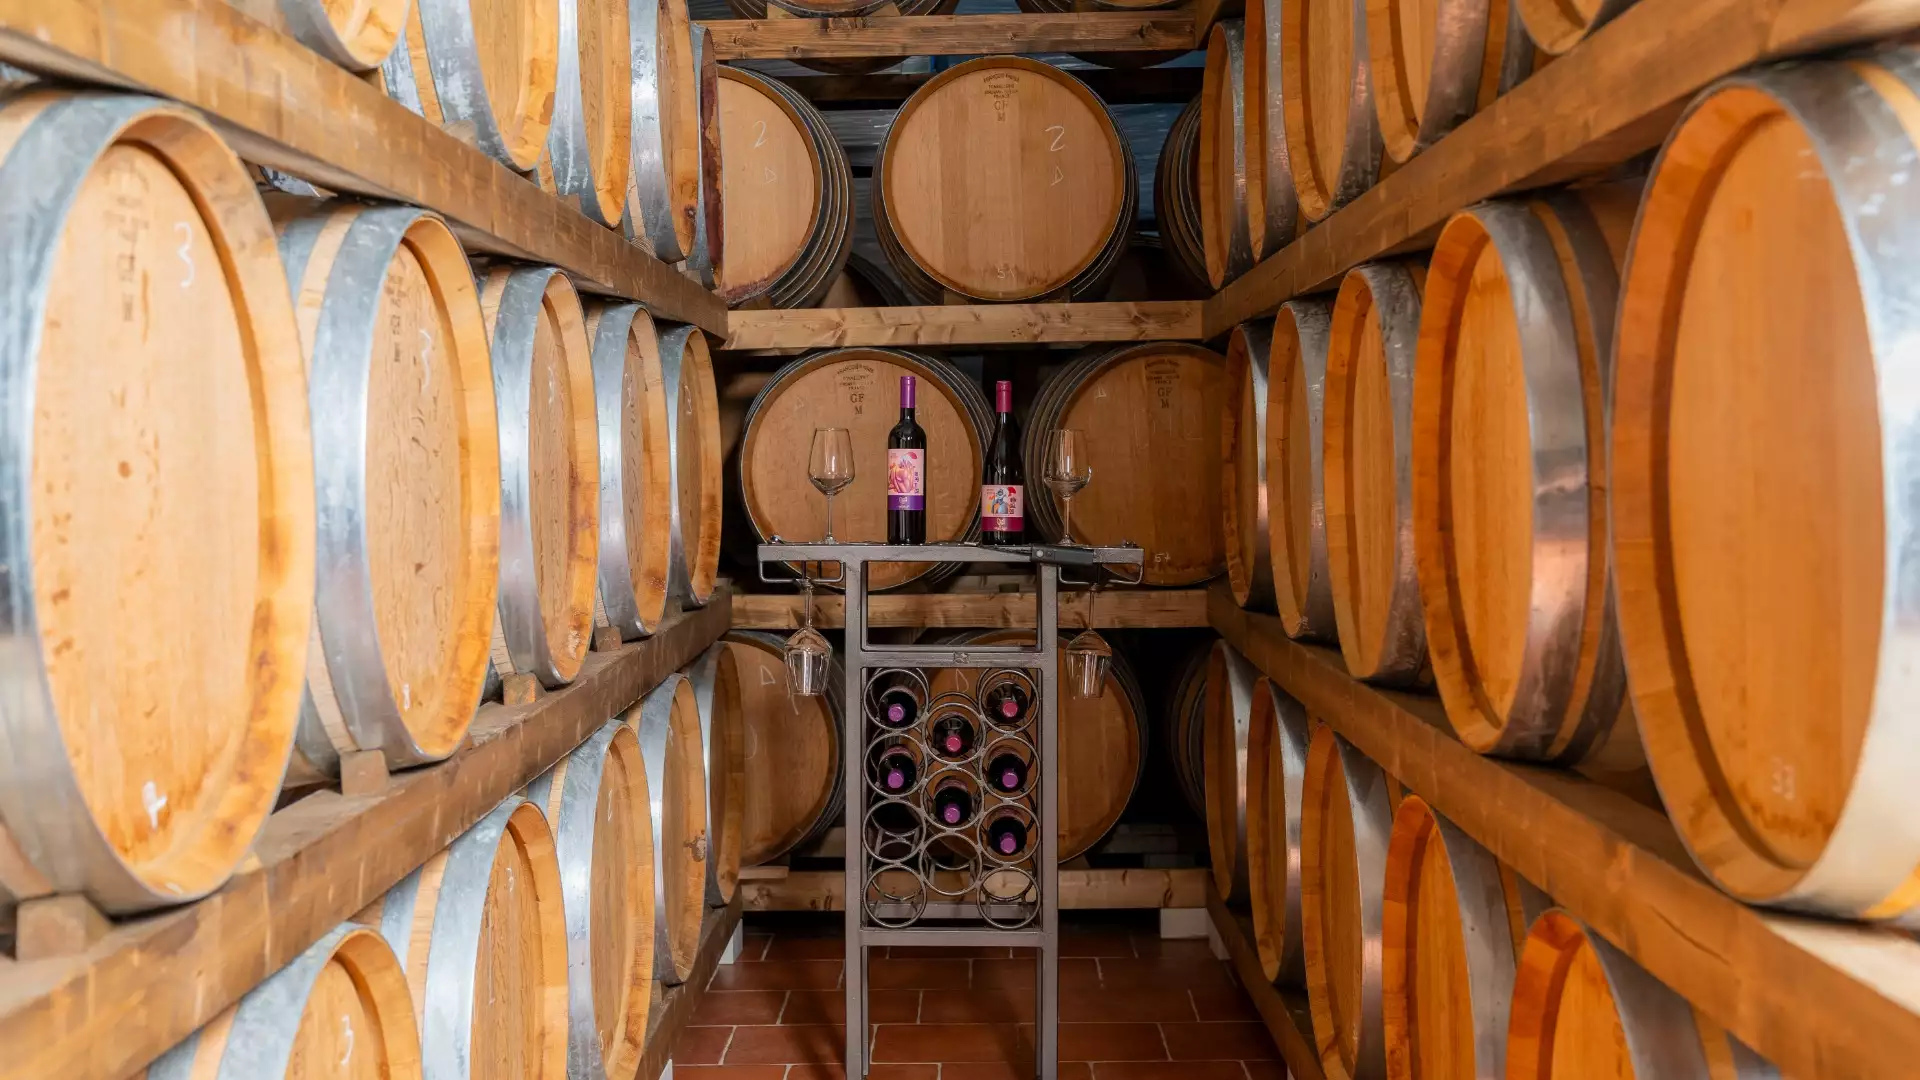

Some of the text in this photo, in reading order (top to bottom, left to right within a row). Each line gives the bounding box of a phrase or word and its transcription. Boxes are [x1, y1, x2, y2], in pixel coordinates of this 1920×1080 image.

[751, 119, 770, 149] 2
[1045, 125, 1066, 152] 2
[173, 220, 195, 289] 3
[850, 393, 865, 404] GF
[1157, 387, 1173, 397] GF
[854, 405, 863, 415] M
